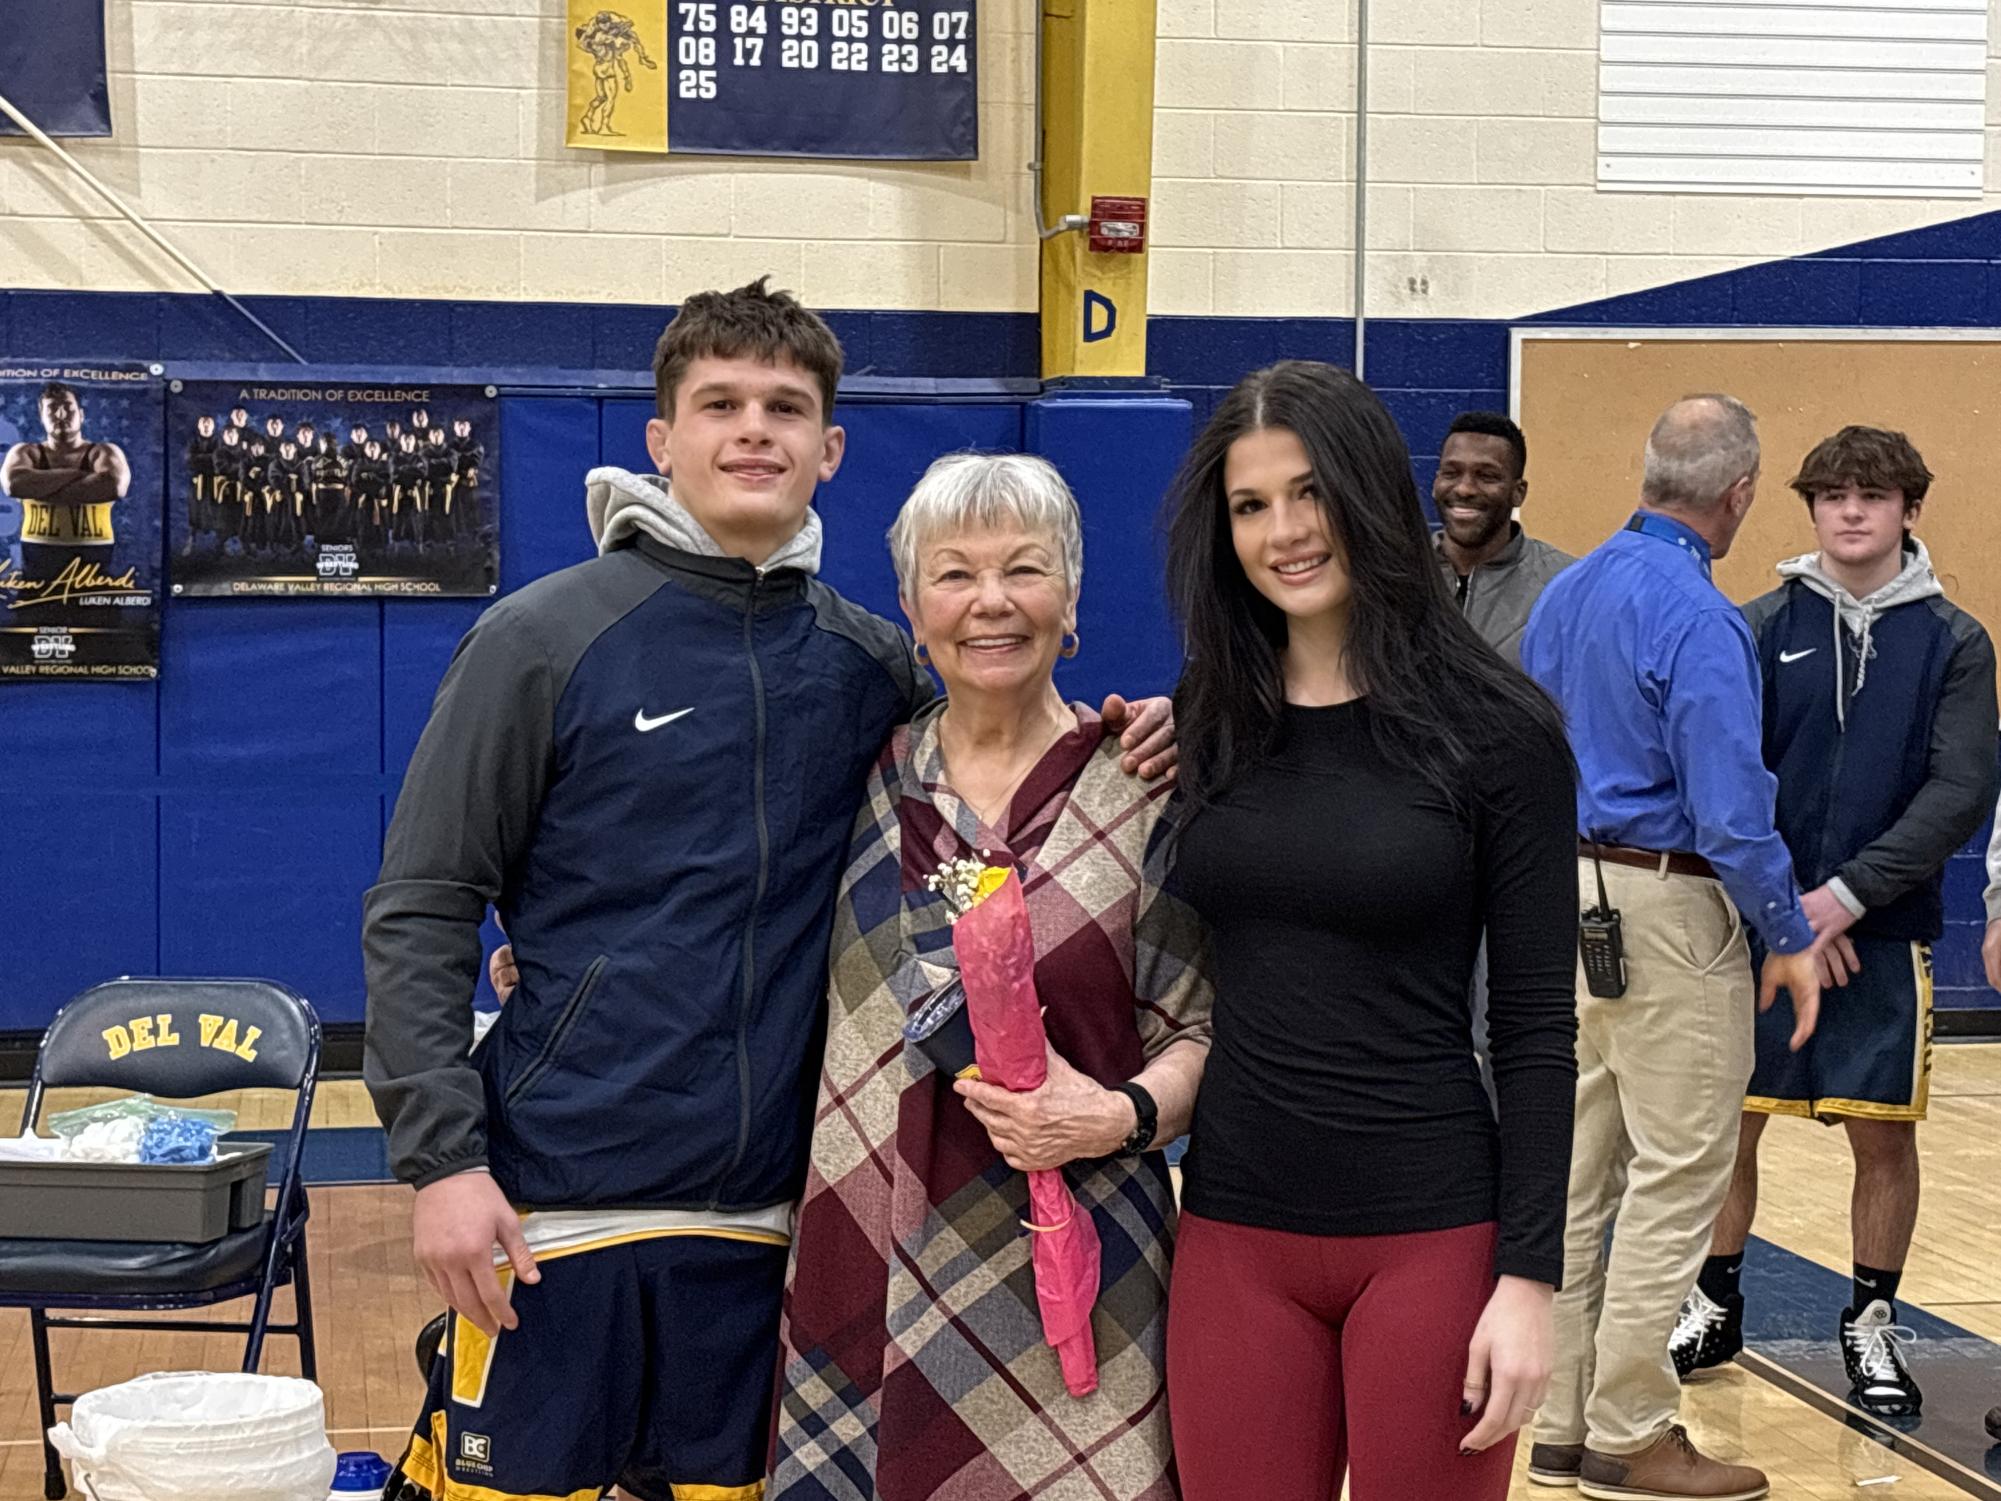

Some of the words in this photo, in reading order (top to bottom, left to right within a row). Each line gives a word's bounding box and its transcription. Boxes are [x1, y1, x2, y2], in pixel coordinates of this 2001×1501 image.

[678, 2, 717, 32] 75
[730, 4, 767, 34] 84
[781, 6, 818, 36] 93
[832, 8, 869, 38] 05
[882, 10, 919, 40] 06
[932, 11, 969, 40] 07
[678, 36, 716, 66] 08
[733, 37, 764, 66] 17
[781, 39, 819, 69] 20
[831, 41, 868, 71] 22
[881, 43, 919, 73] 23
[930, 44, 968, 74] 24
[679, 69, 717, 99] 25
[1083, 289, 1117, 342] D
[40, 368, 60, 378] OF
[63, 369, 149, 381] EXCELLENCE
[239, 389, 250, 400] A
[252, 388, 322, 401] TRADITION
[325, 389, 344, 401] OF
[347, 390, 430, 402] EXCELLENCE
[27, 504, 60, 537] DEL
[69, 504, 103, 538] VAL
[233, 582, 285, 592] DELAWARE
[288, 582, 321, 592] VALLEY
[323, 582, 372, 592] REGIONAL
[374, 582, 399, 592] HIGH
[400, 581, 441, 592] SCHOOL
[79, 596, 111, 606] LUKEN
[2, 664, 37, 674] VALLEY
[39, 664, 89, 674] REGIONAL
[91, 664, 117, 674] HIGH
[118, 664, 151, 675] SCHOO
[101, 1013, 180, 1061] DEL
[198, 1013, 263, 1063] VAL
[464, 1435, 487, 1459] BC
